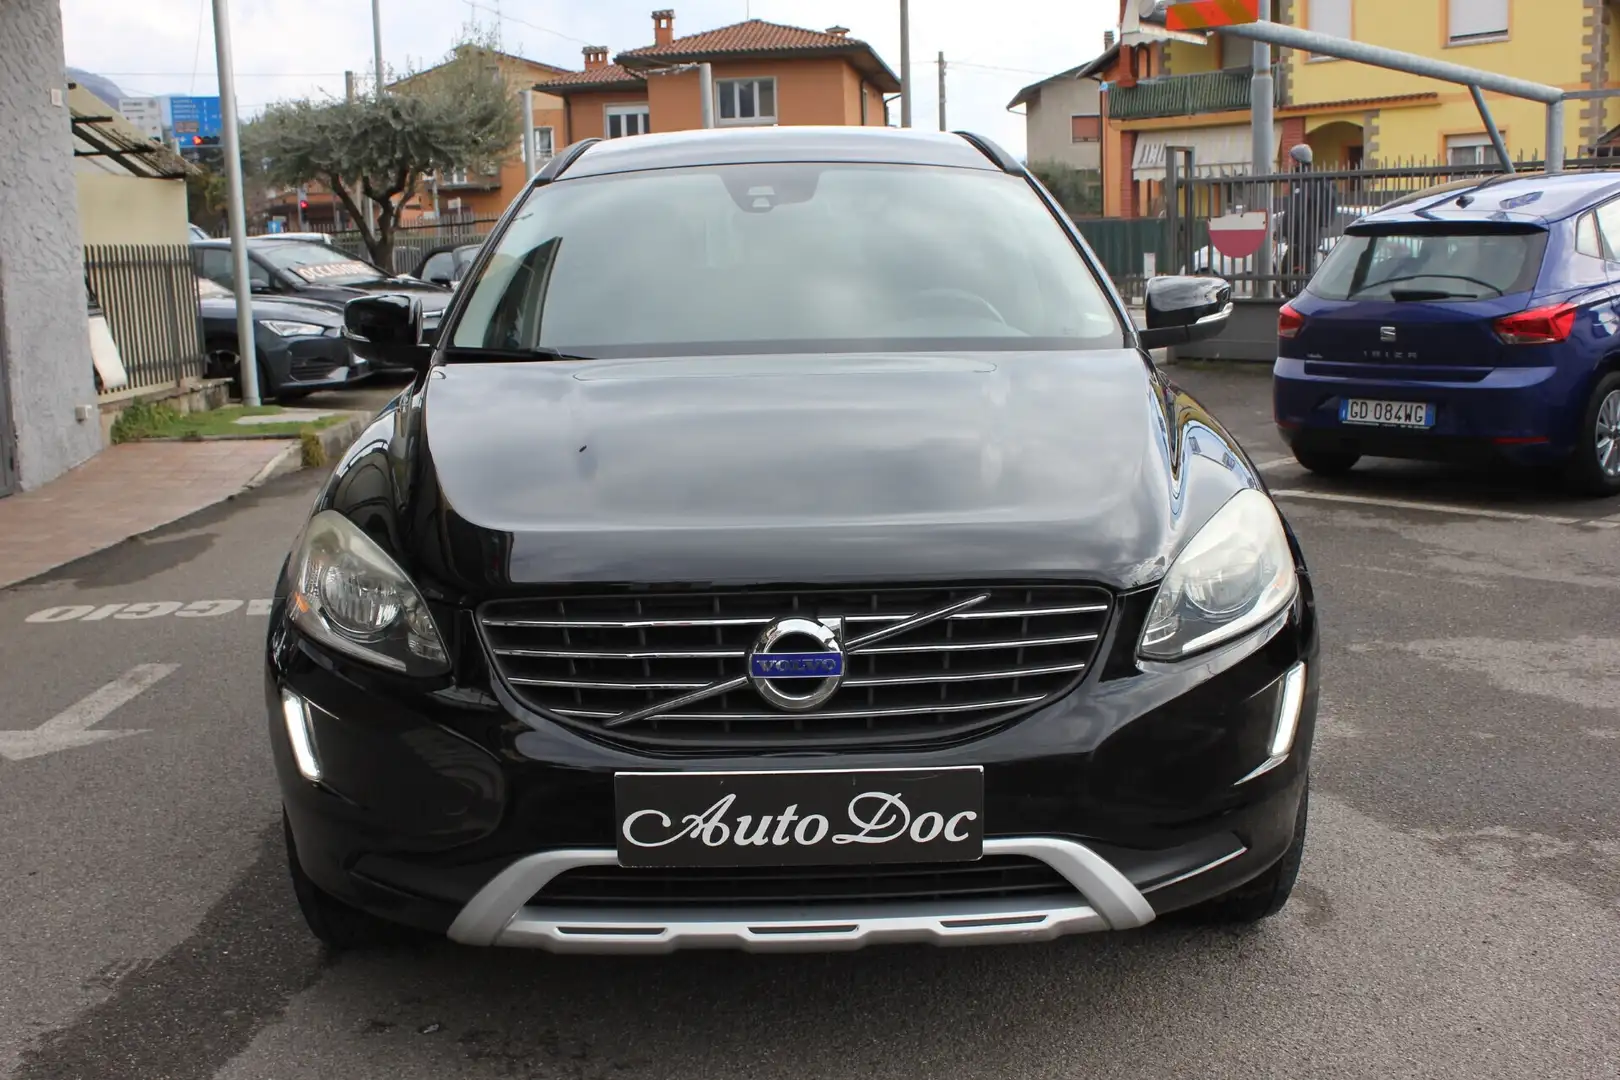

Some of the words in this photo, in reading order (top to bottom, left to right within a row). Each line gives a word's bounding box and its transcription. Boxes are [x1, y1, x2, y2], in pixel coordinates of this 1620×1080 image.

[1350, 401, 1368, 419] GD
[1374, 402, 1424, 423] 084WG
[756, 659, 837, 672] VOLVO
[622, 793, 829, 847] Auto
[832, 791, 977, 844] Doc
